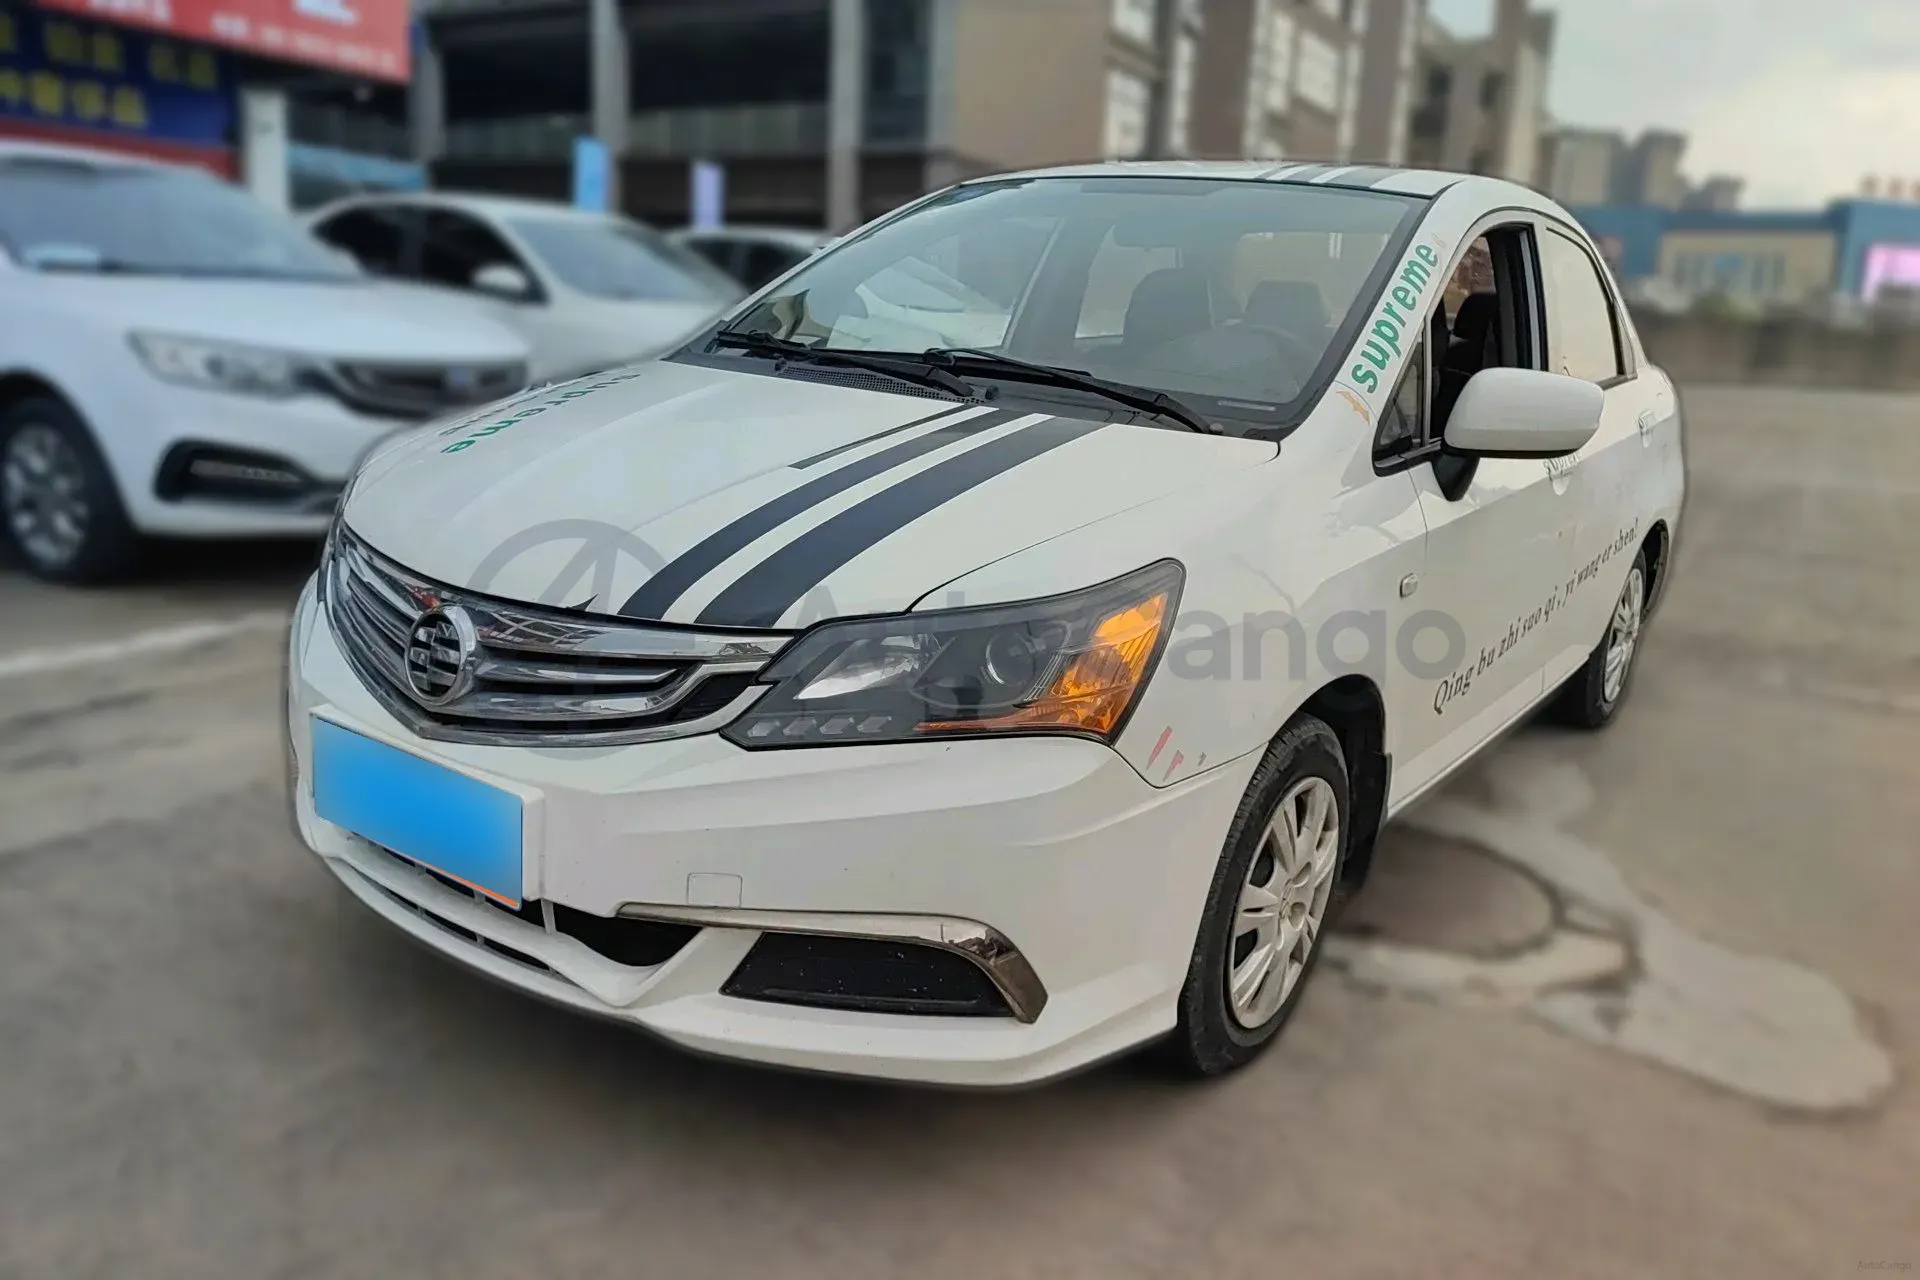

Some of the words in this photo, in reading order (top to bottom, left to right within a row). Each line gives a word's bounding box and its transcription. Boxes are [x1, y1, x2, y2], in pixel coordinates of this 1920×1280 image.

[1351, 244, 1439, 394] supreme
[1434, 664, 1475, 715] Qing
[1477, 646, 1495, 676] bu
[1498, 616, 1521, 658] zhi
